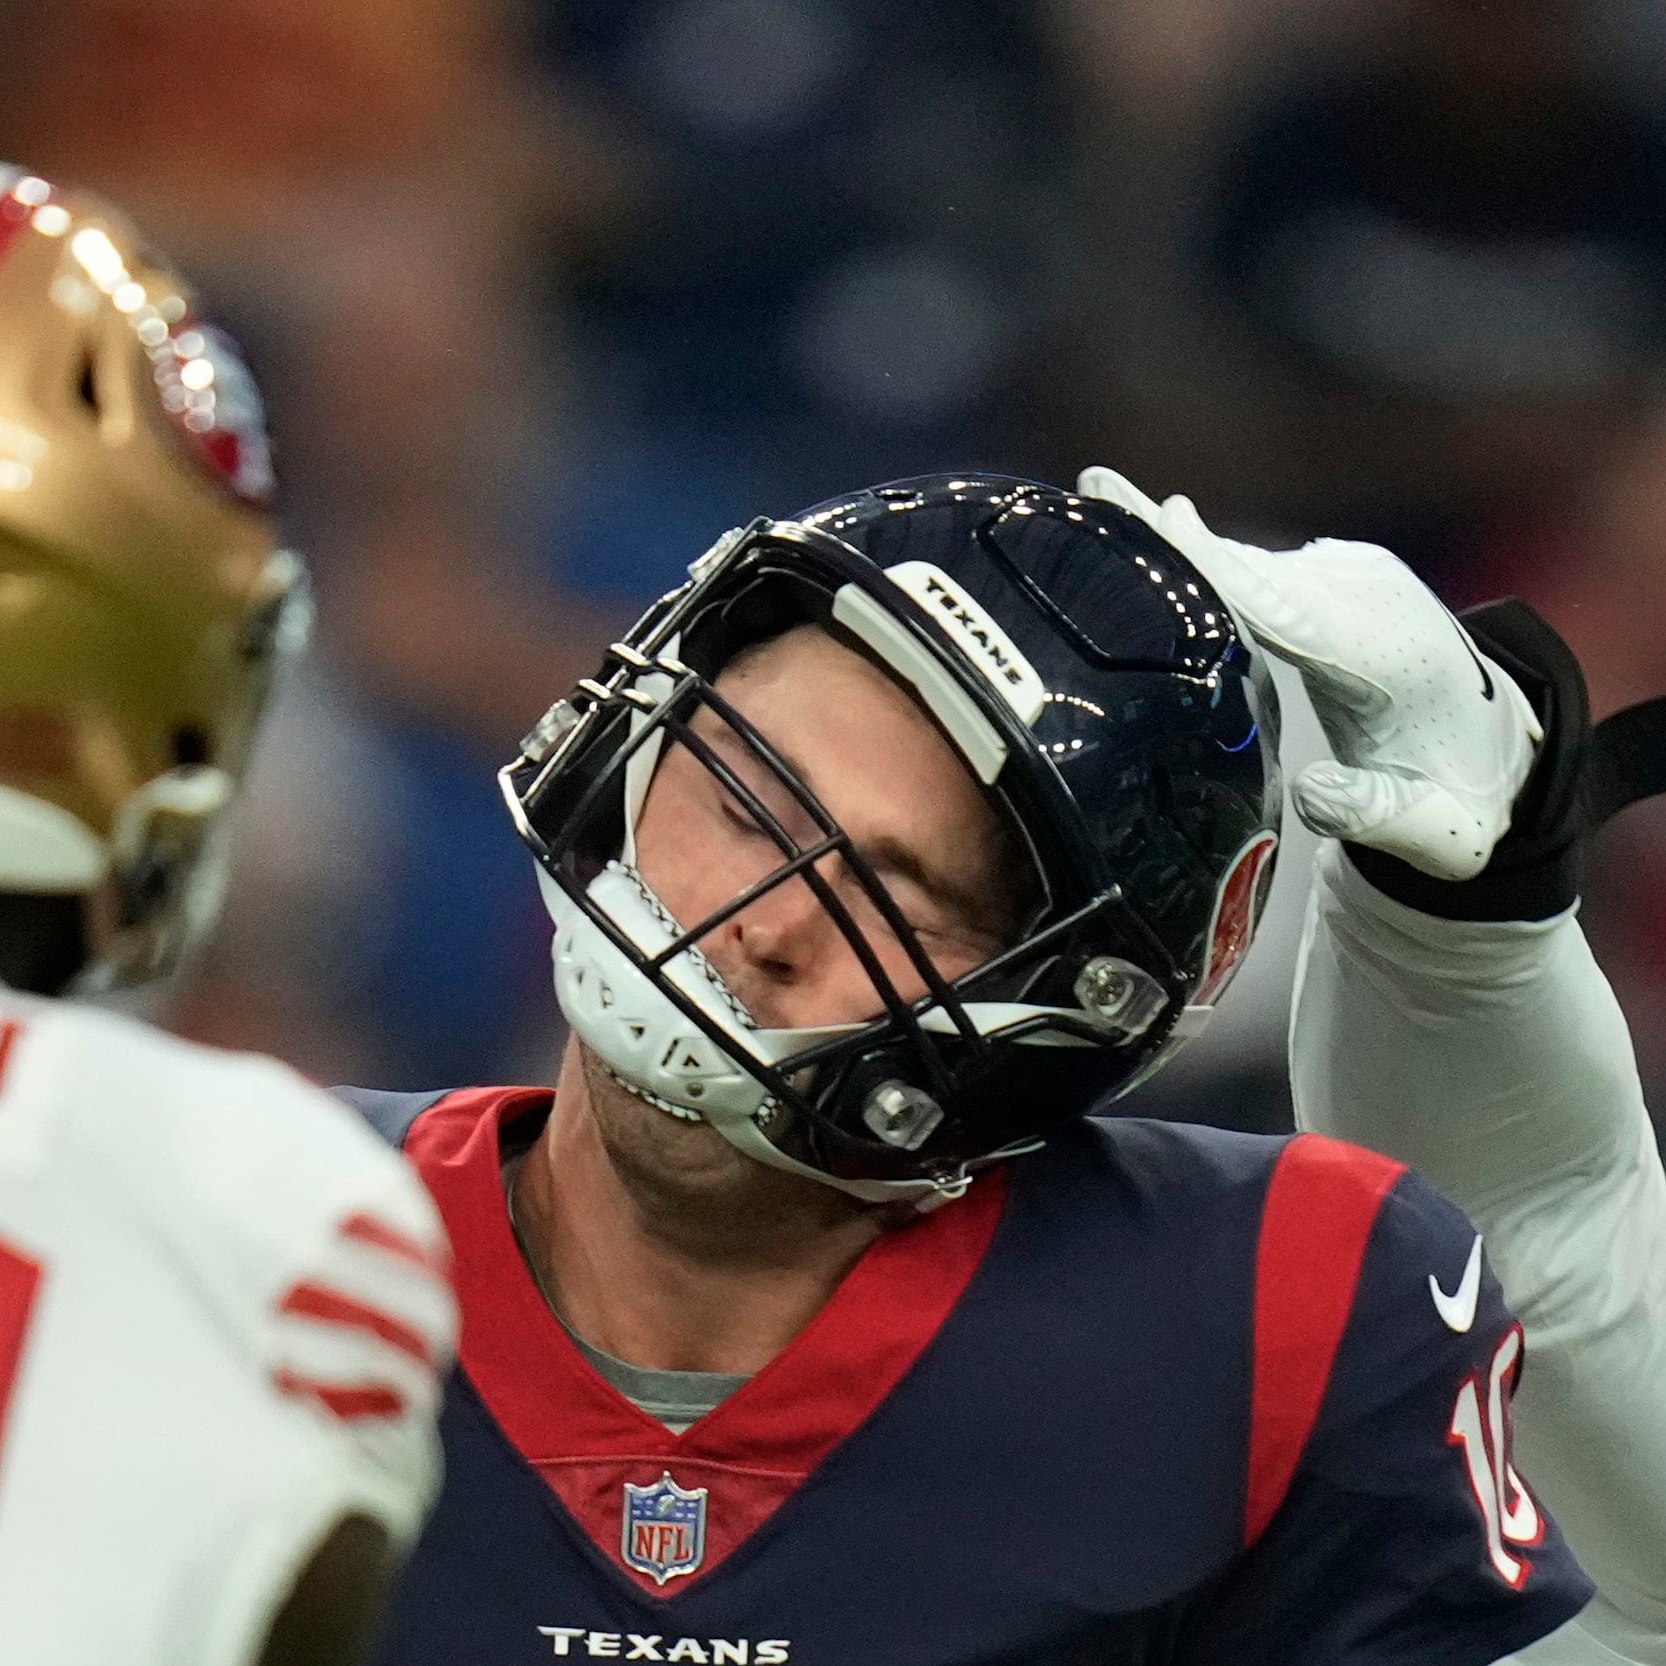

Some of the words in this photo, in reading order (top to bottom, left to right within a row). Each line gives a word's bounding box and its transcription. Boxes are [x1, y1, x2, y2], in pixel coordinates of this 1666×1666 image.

[926, 576, 1022, 685] TEXANS
[634, 1523, 694, 1566] NFL
[537, 1624, 792, 1666] TEXANS
